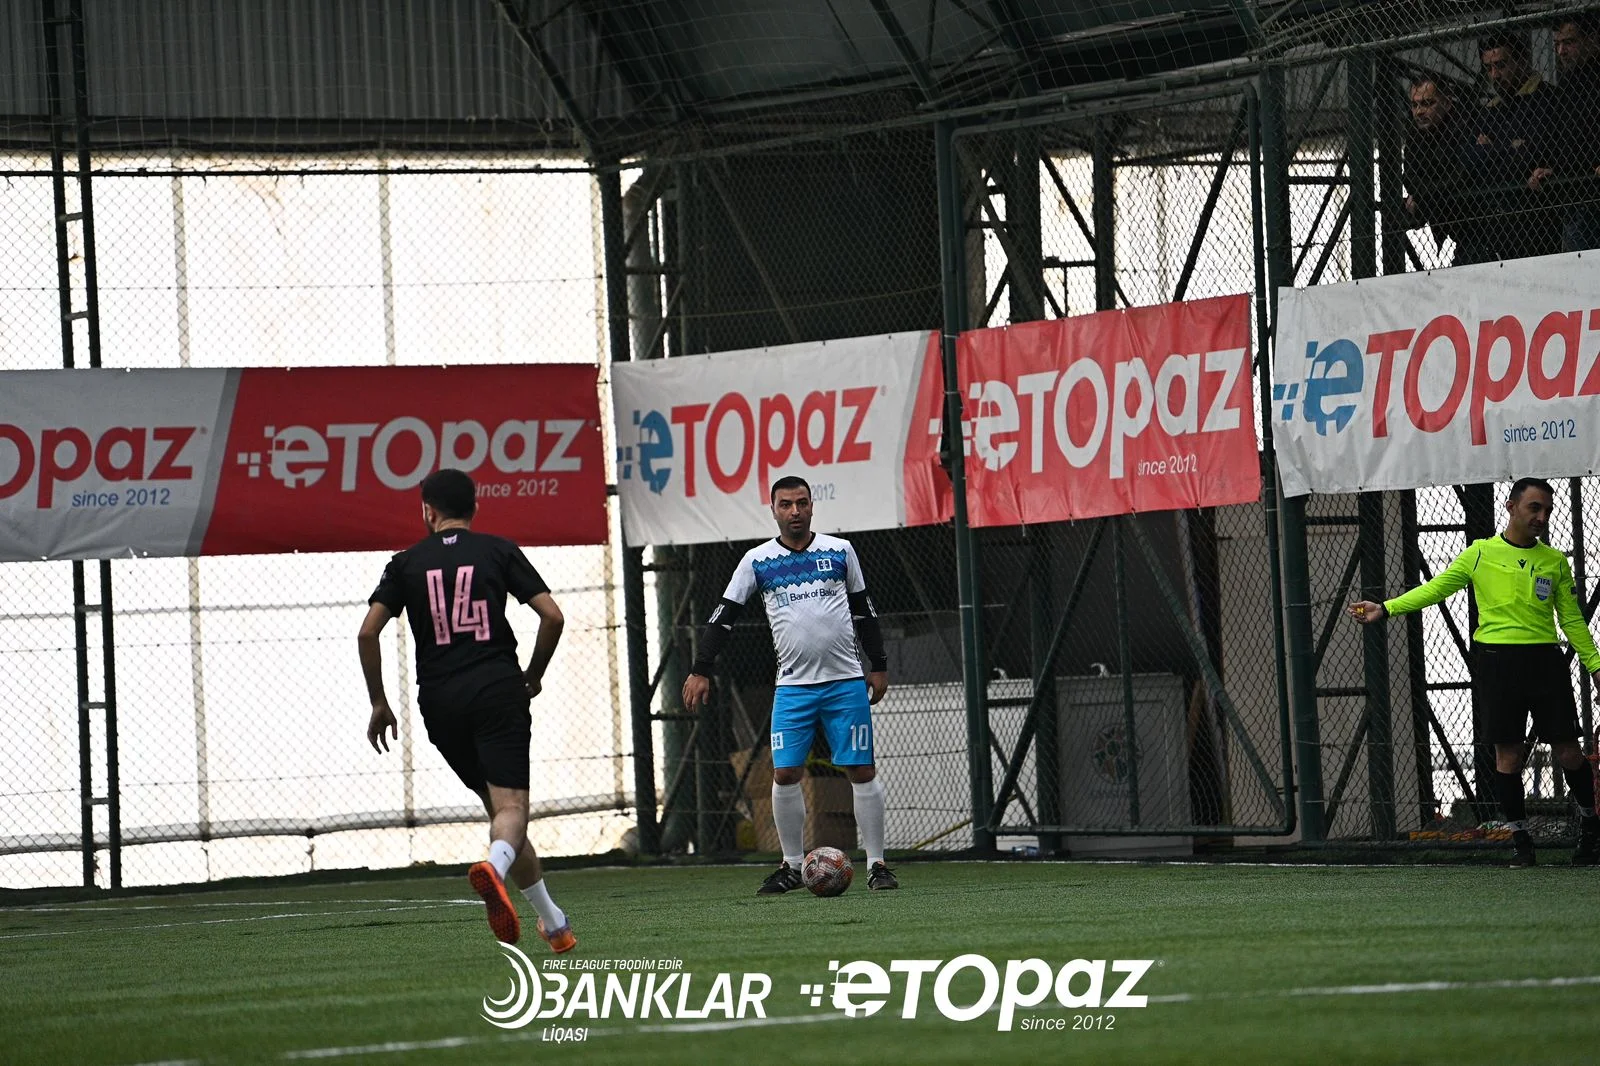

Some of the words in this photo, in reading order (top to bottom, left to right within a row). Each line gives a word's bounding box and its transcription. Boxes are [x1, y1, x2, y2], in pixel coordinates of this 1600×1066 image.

[1503, 425, 1537, 442] since
[1542, 419, 1577, 440] 2012
[1137, 458, 1166, 477] since
[1169, 453, 1197, 474] 2012
[72, 490, 119, 507] since
[126, 488, 171, 506] 2012
[516, 478, 558, 496] 2012
[1536, 577, 1551, 586] FIFA
[426, 565, 491, 646] 14
[790, 591, 810, 601] Bank
[850, 725, 868, 750] 10
